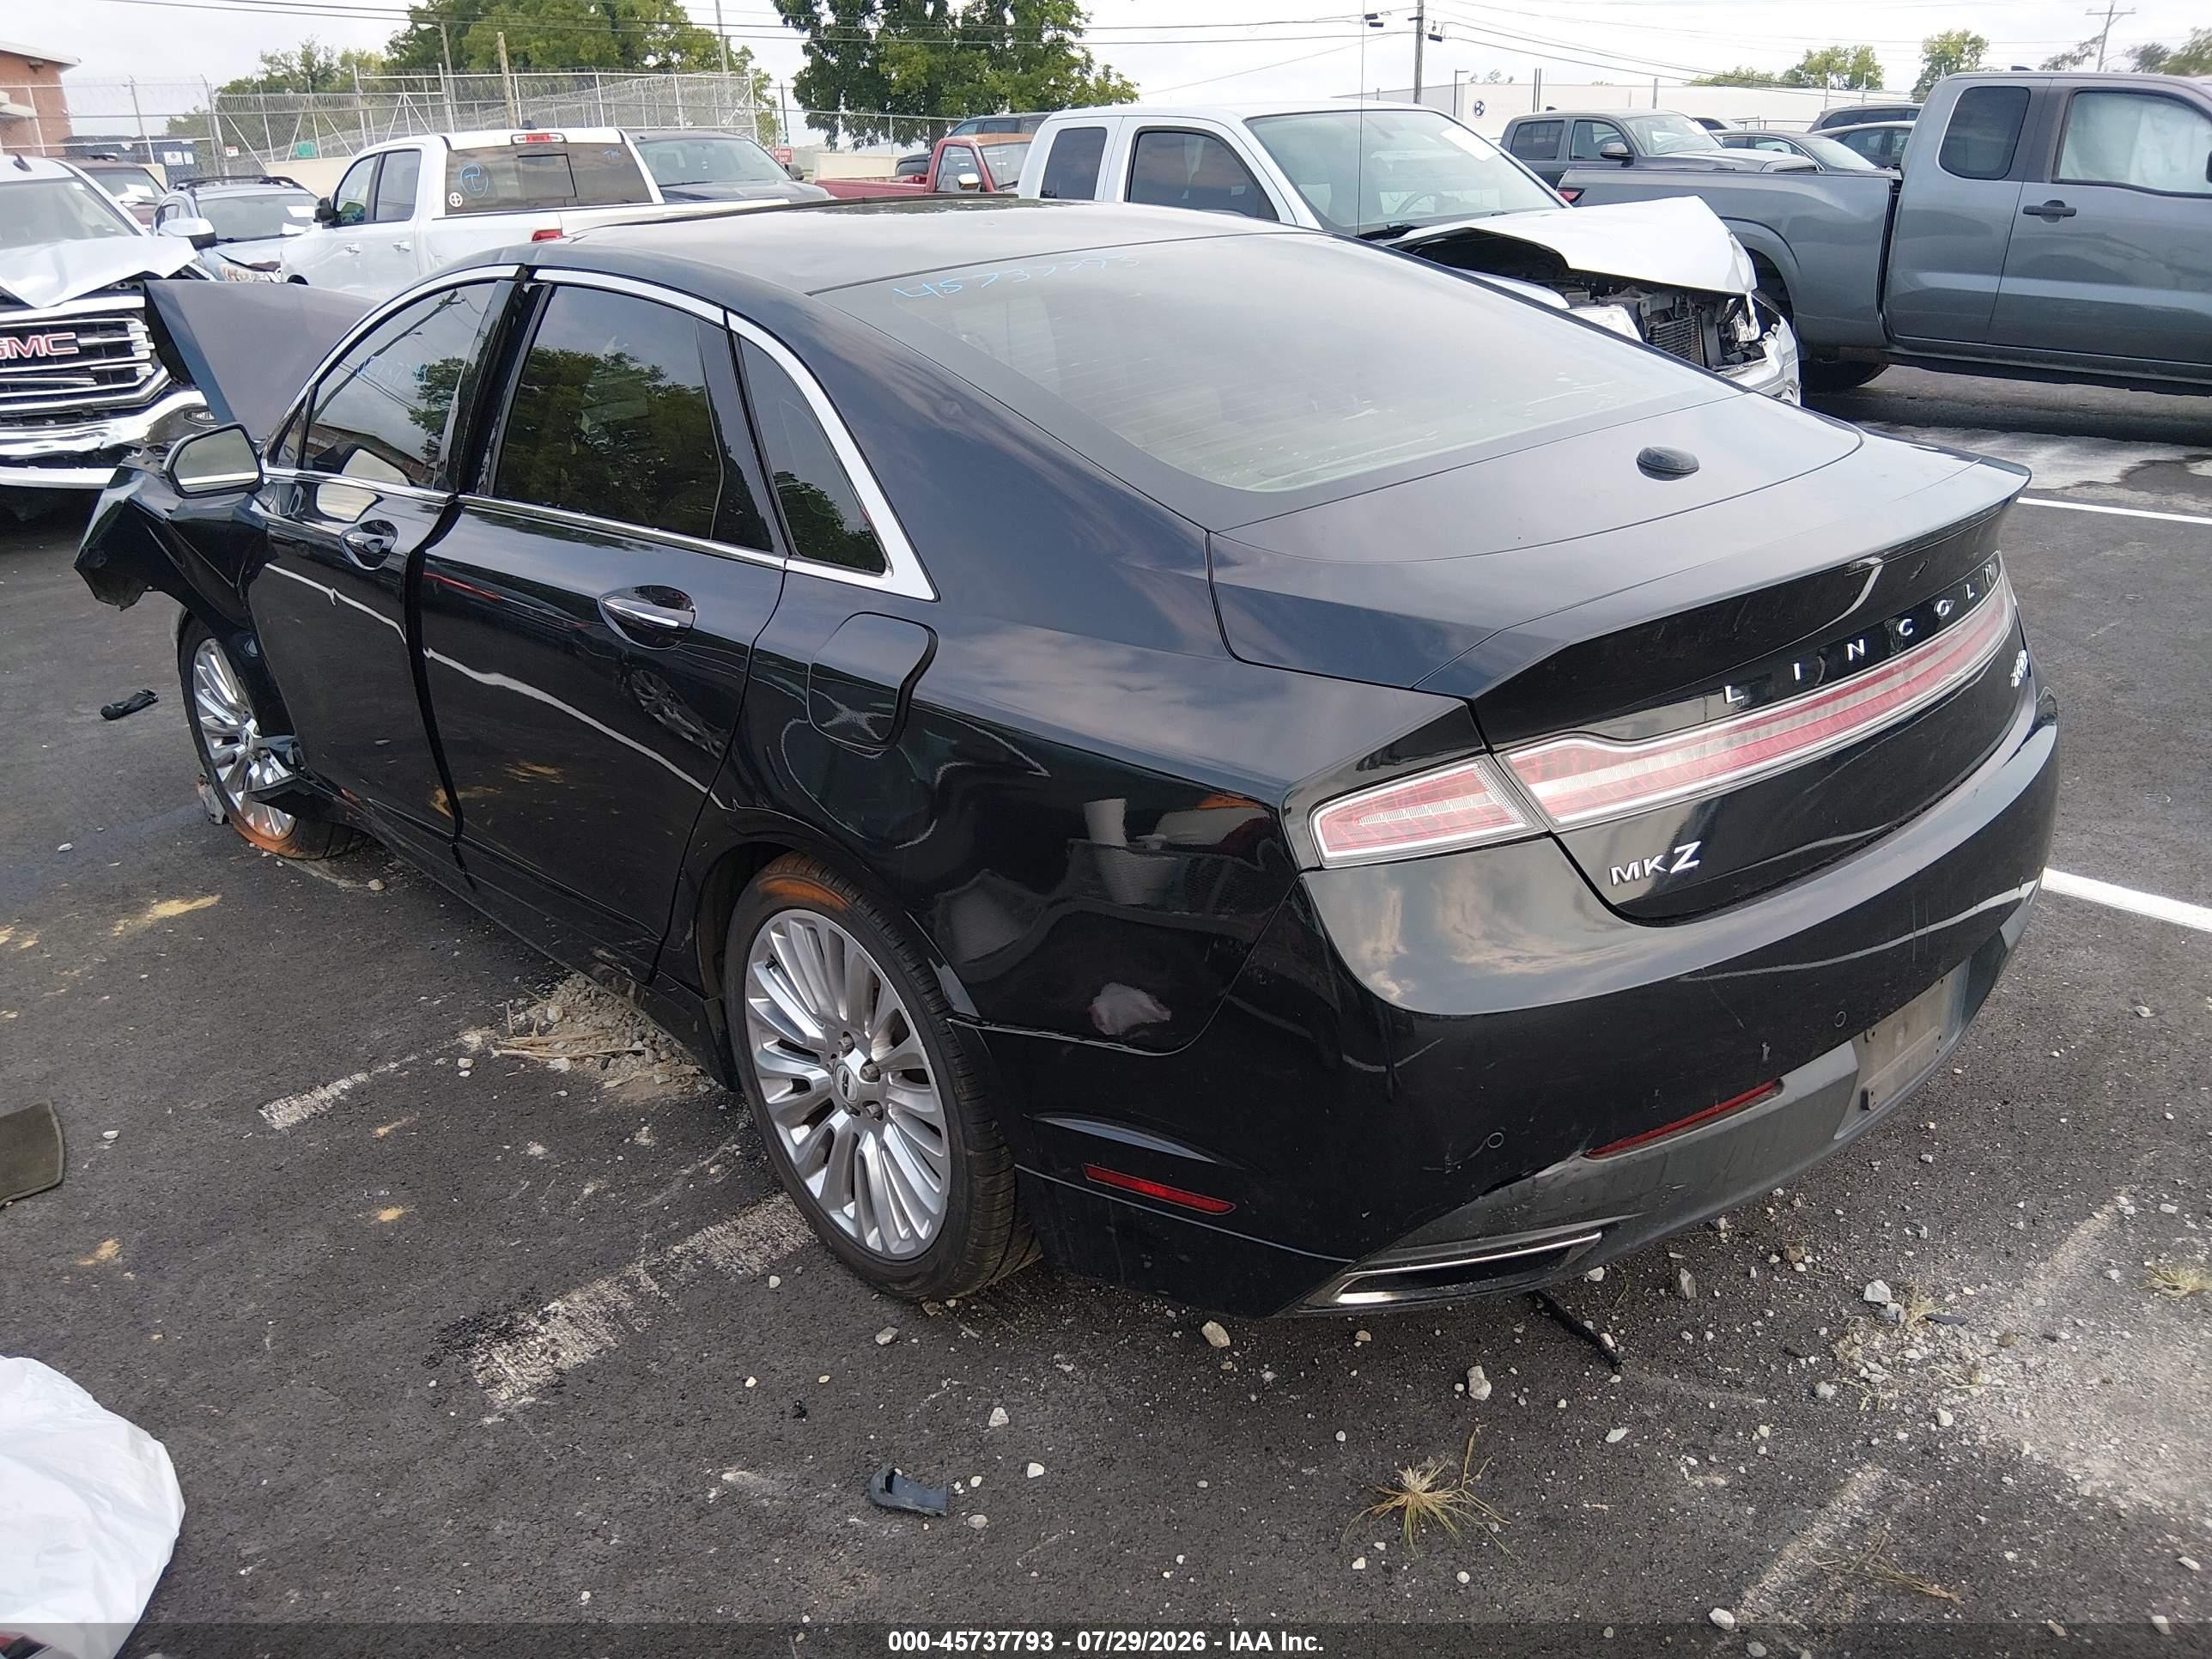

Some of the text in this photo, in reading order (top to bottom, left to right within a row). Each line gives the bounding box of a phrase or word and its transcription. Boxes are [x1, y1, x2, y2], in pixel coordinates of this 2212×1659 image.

[0, 331, 80, 360] MC
[1724, 560, 1998, 704] LINCOLN
[1609, 841, 1702, 886] MKZ
